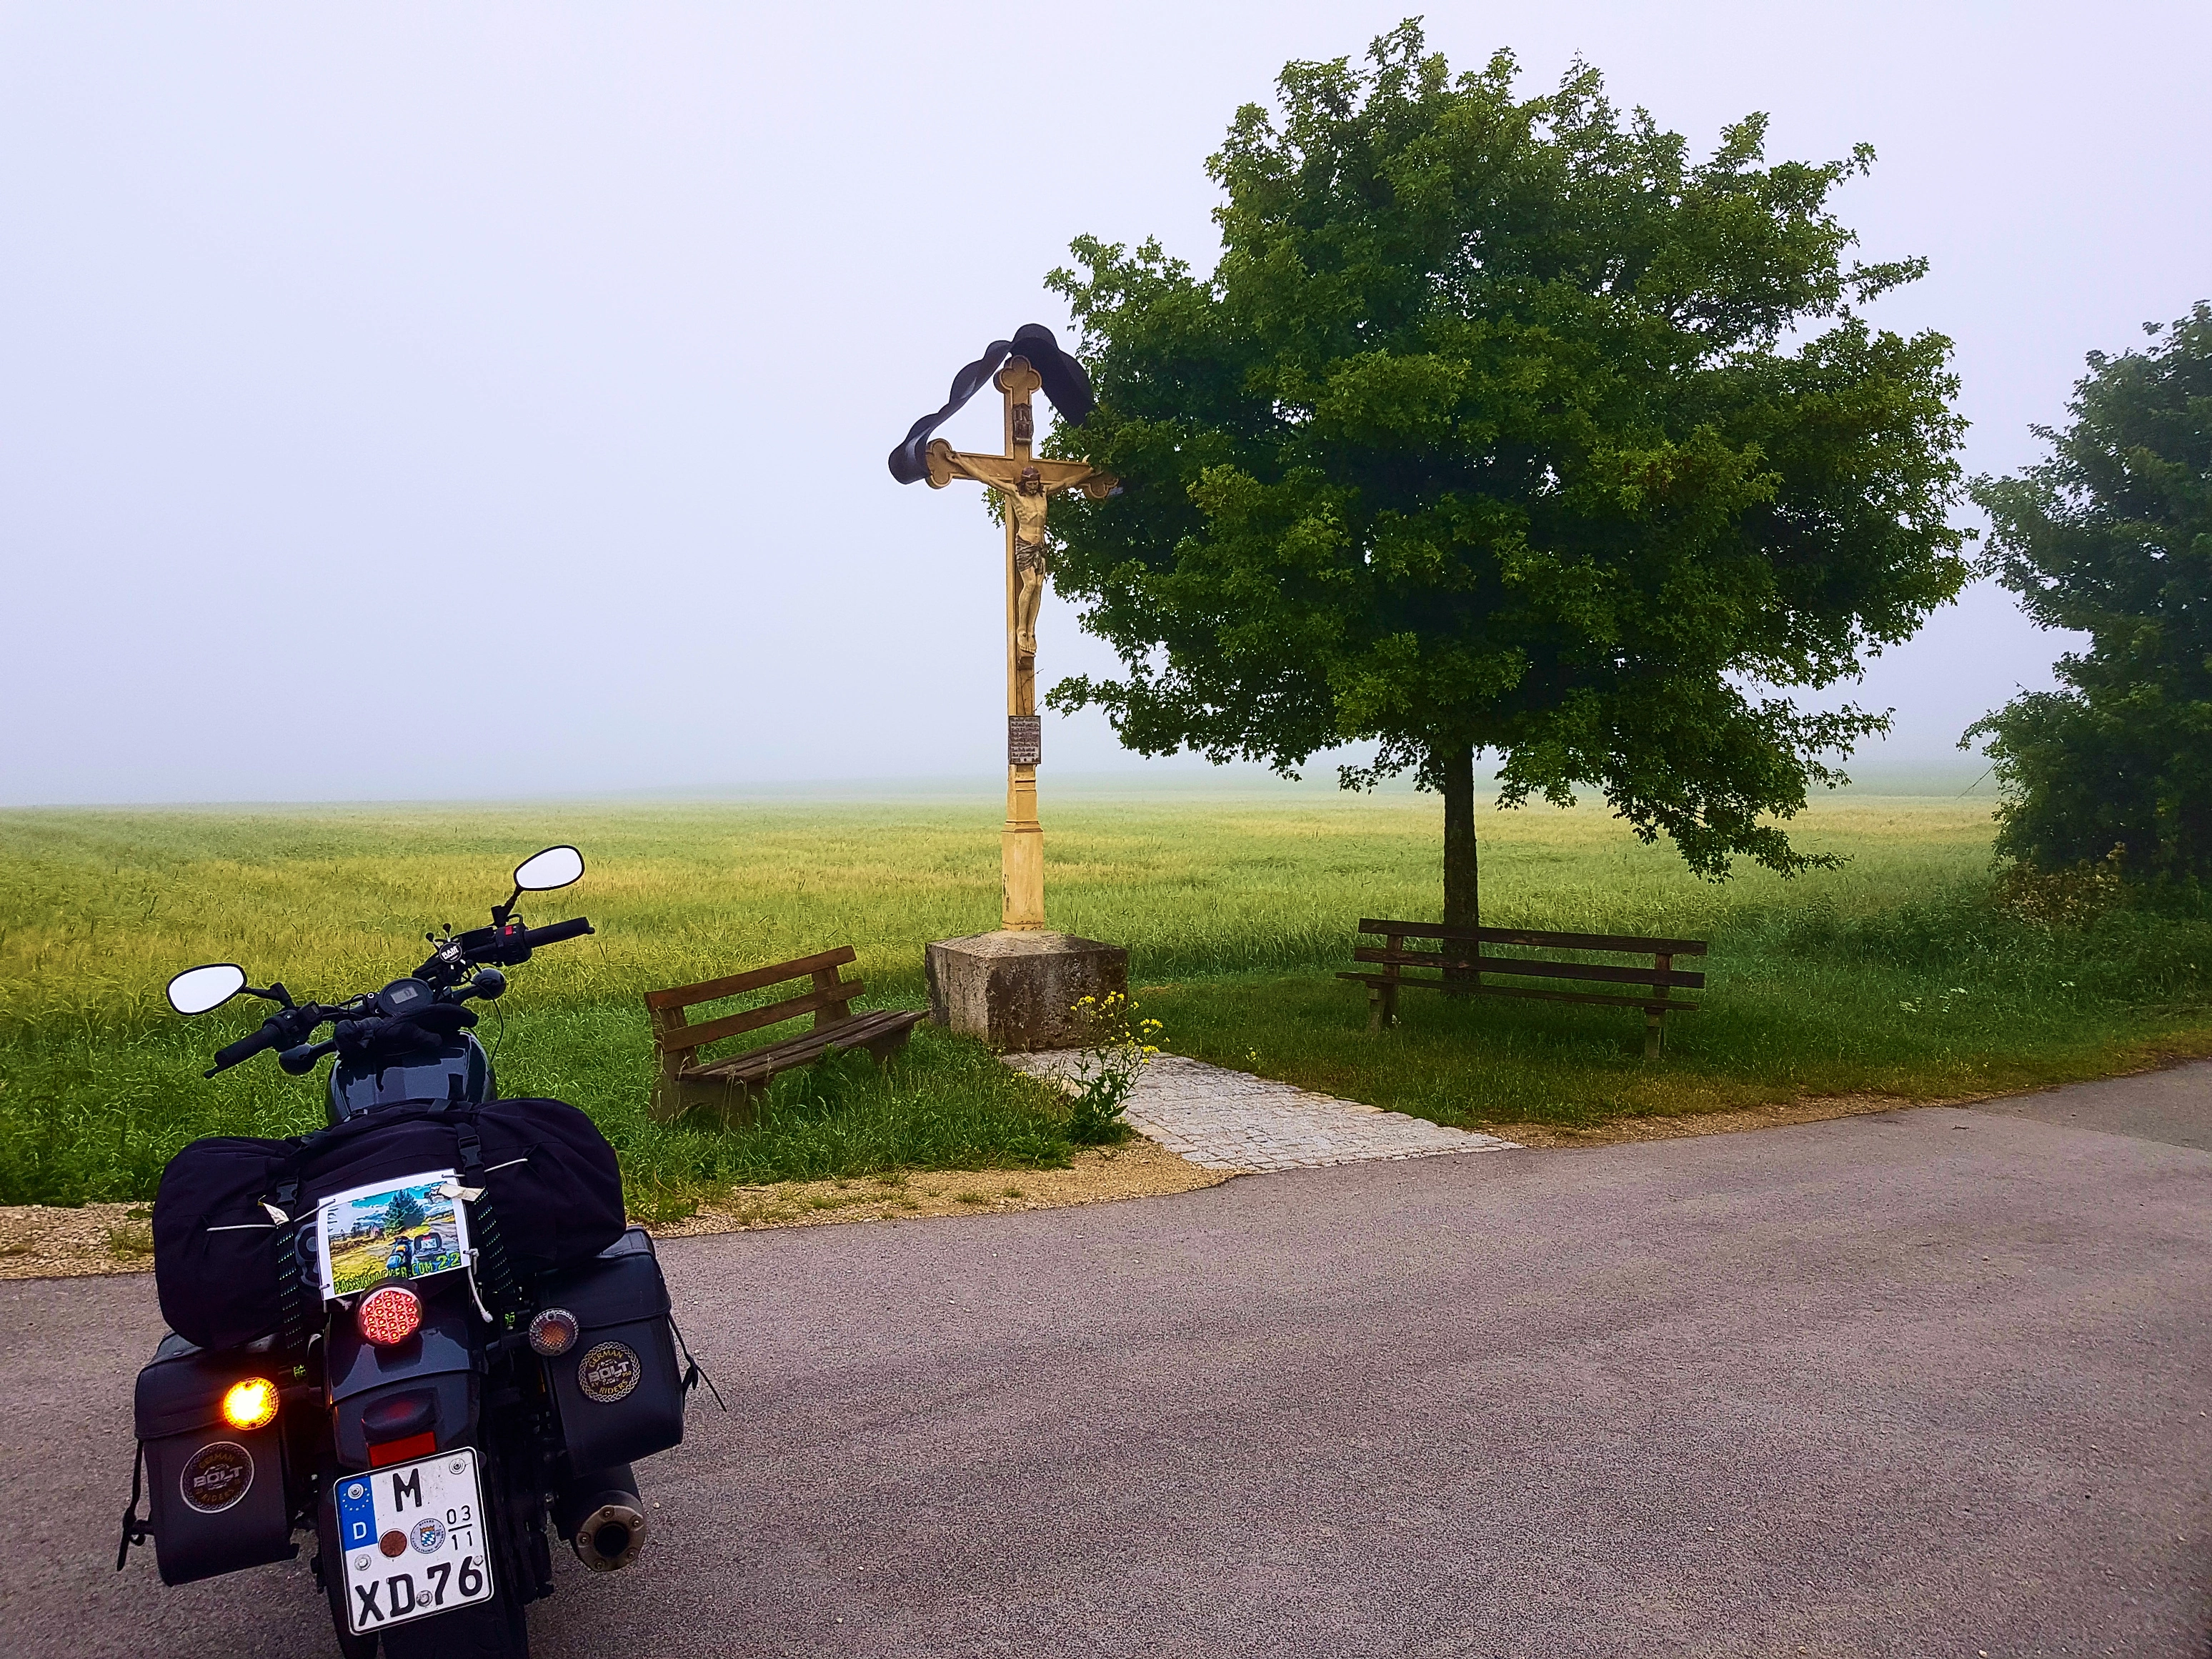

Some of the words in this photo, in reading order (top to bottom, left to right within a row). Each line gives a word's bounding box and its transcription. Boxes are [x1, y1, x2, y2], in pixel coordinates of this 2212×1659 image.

[441, 945, 459, 960] RAM
[436, 1252, 461, 1270] 22
[589, 1349, 624, 1368] GERMAN
[588, 1361, 629, 1383] BOLT
[599, 1379, 628, 1395] RIDERS
[194, 1466, 243, 1488] BOLT
[392, 1468, 422, 1513] M
[446, 1505, 472, 1525] 03
[352, 1521, 367, 1540] D
